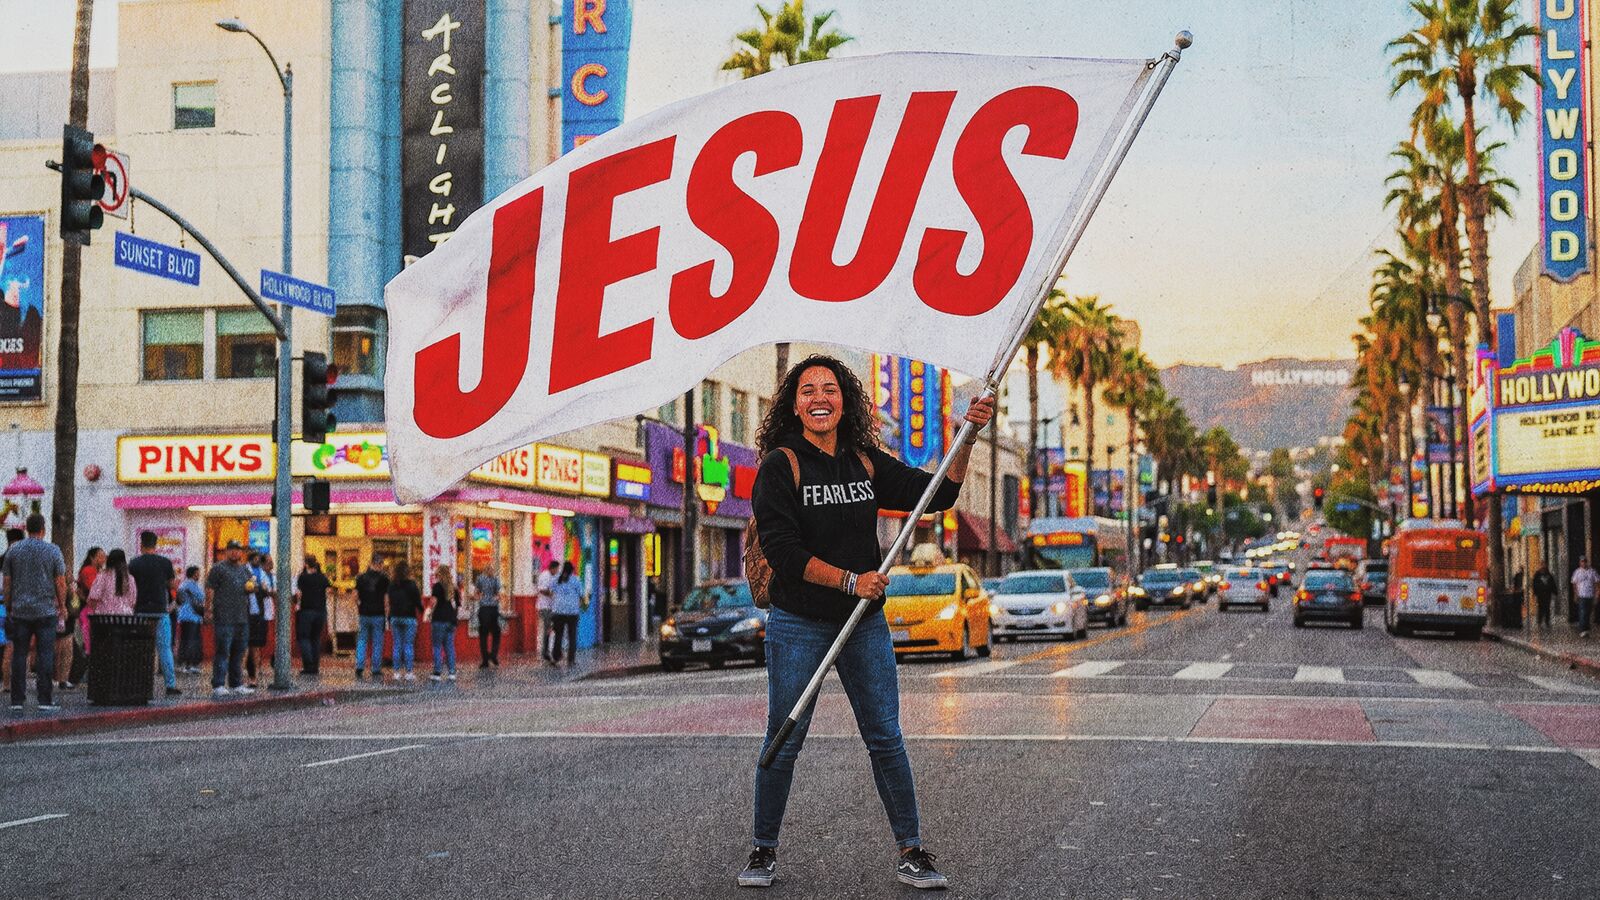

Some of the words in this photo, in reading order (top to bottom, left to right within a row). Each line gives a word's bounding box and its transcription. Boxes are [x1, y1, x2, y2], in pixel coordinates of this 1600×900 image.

[571, 0, 608, 149] RC
[120, 240, 163, 270] SUNSET
[168, 253, 195, 278] BLVD
[413, 85, 1079, 439] JESUS
[313, 290, 333, 310] BLVD
[1252, 368, 1349, 385] HOLLYWOOD
[139, 443, 262, 474] PINKS
[481, 450, 528, 477] INKS
[542, 454, 579, 484] PINKS
[803, 480, 874, 506] FEARLESS
